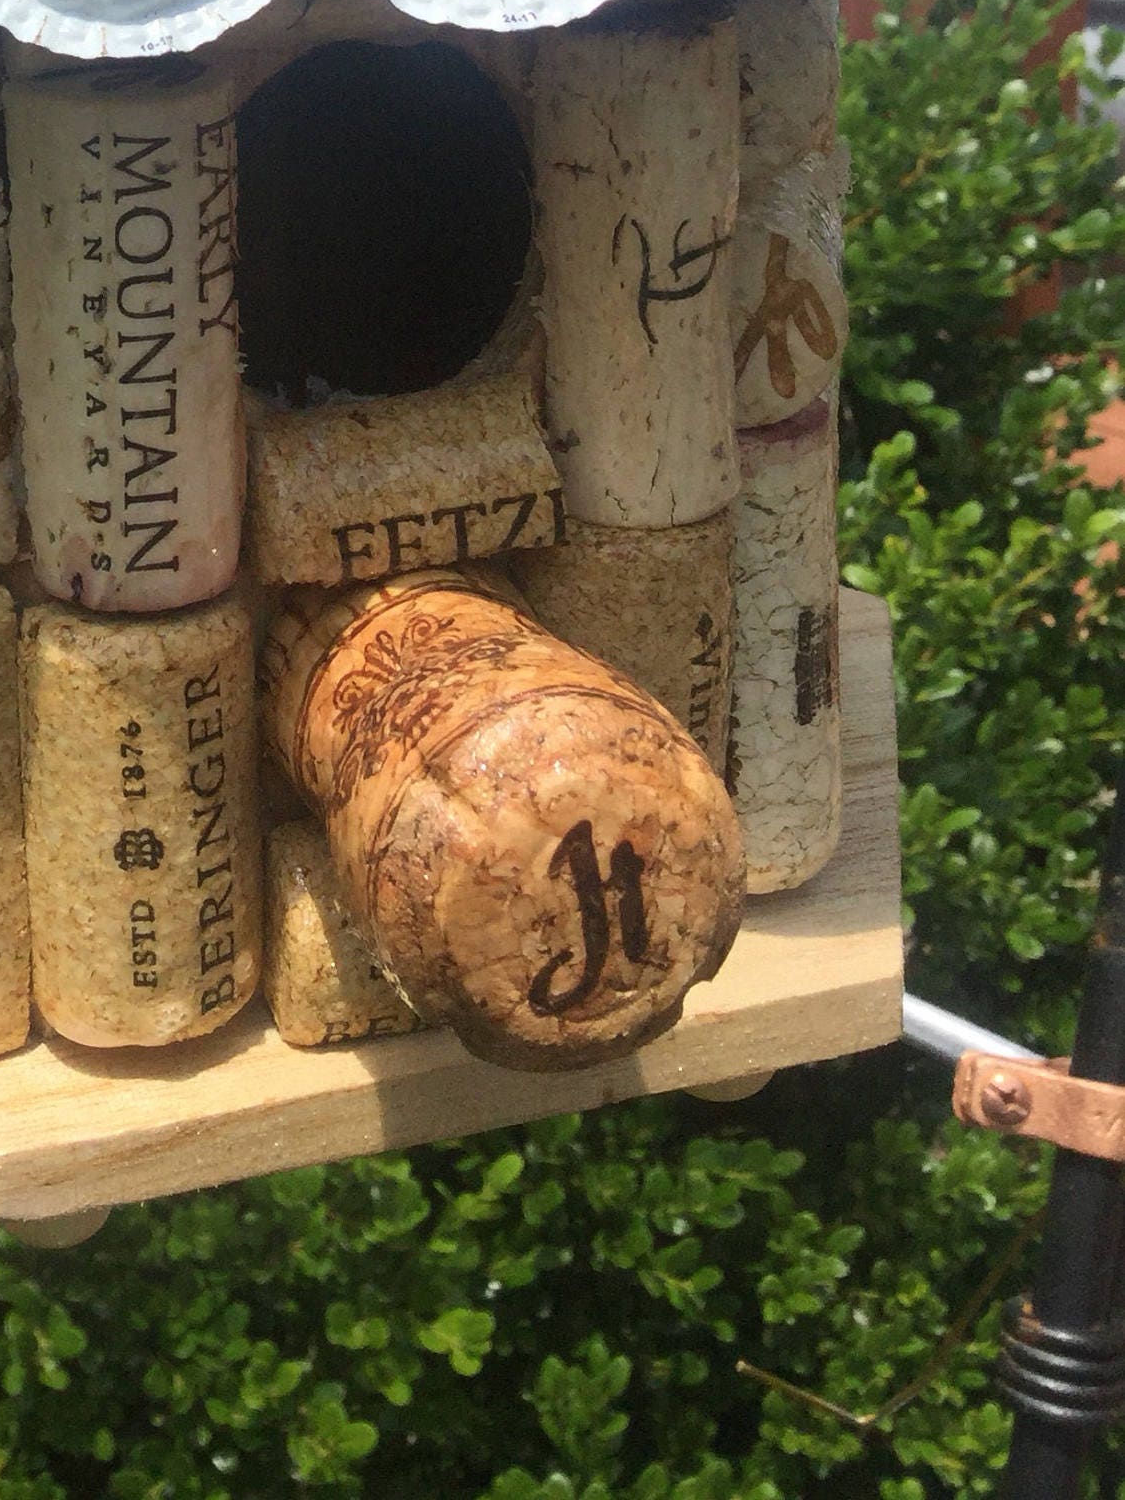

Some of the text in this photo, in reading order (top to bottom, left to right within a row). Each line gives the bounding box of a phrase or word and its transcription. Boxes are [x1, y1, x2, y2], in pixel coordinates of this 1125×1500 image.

[113, 130, 182, 575] MOUNTAIN
[194, 109, 241, 338] EARLY
[120, 719, 159, 989] ESTD 1876
[185, 662, 237, 1018] BERINGER
